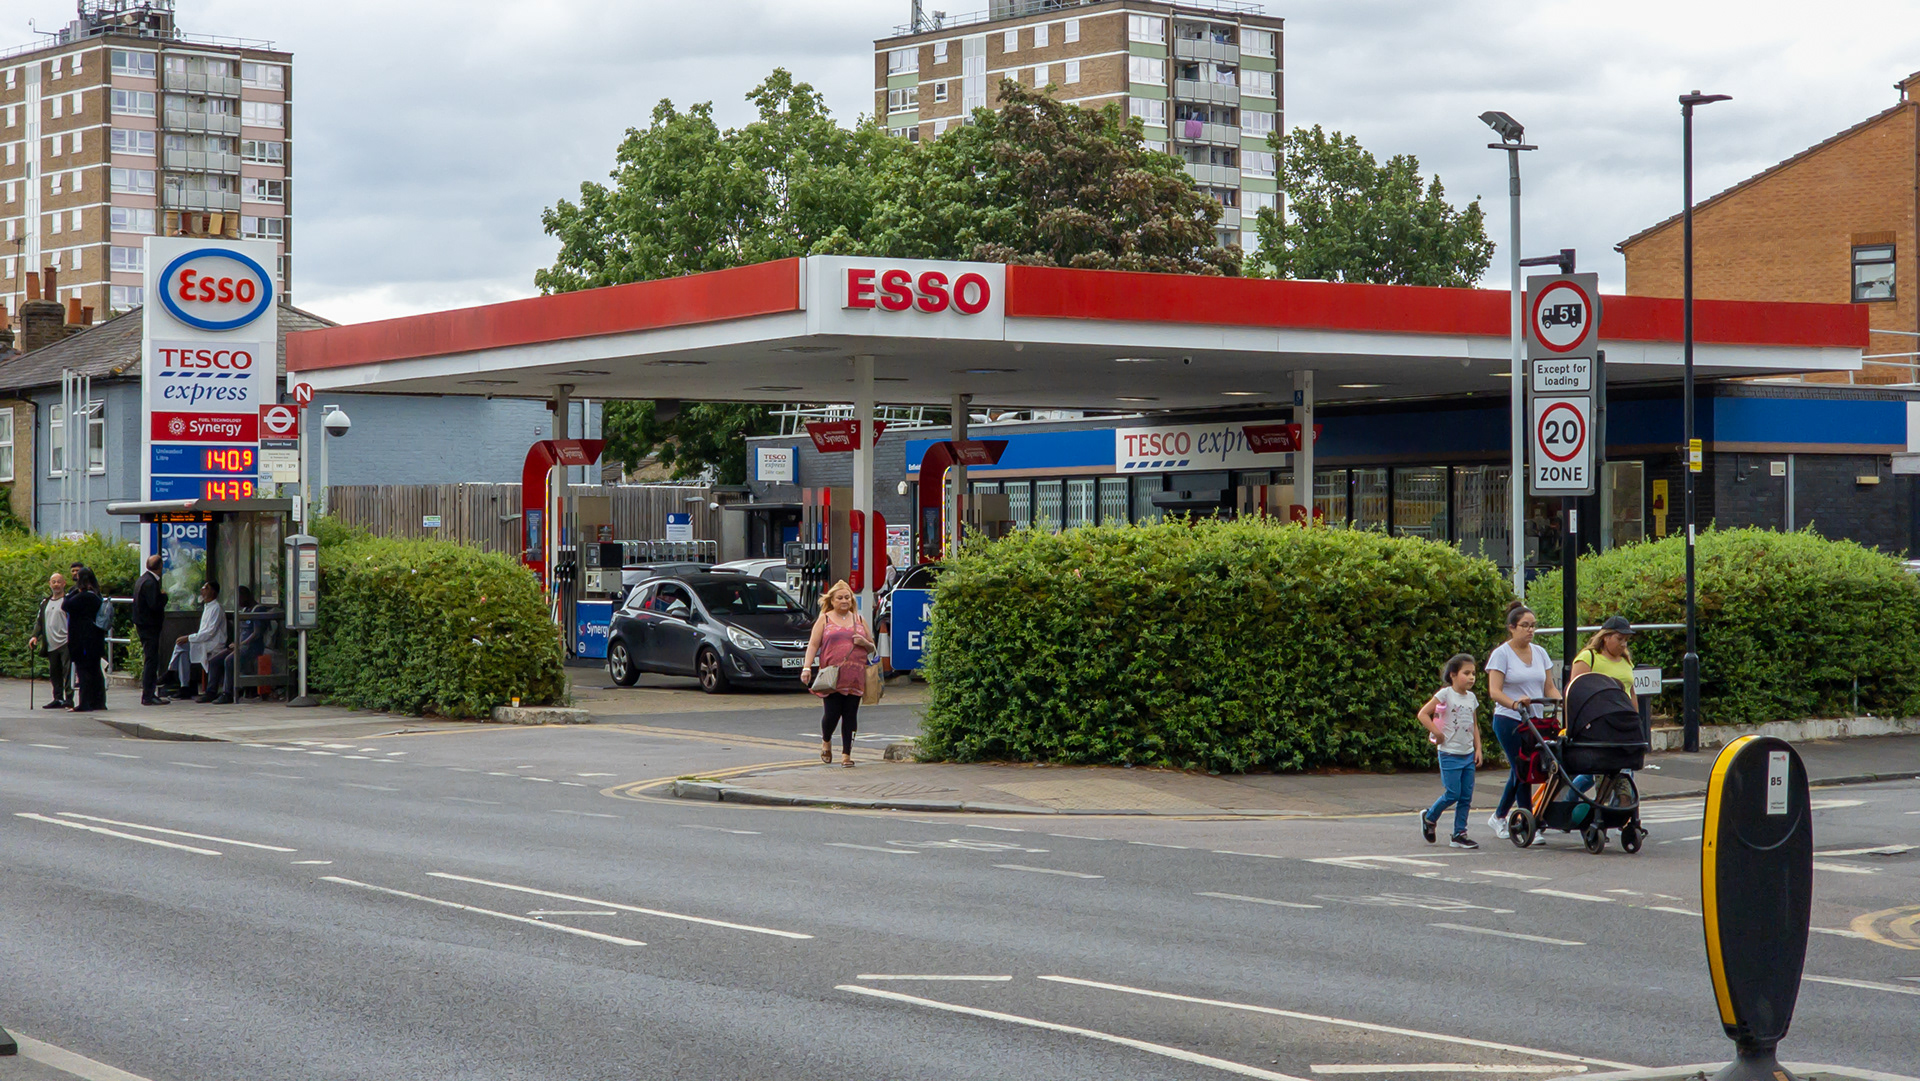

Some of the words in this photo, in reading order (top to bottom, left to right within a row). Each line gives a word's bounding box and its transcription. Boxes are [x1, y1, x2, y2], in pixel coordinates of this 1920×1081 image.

[179, 269, 255, 303] Esso
[847, 268, 991, 315] ESSO
[158, 348, 252, 369] TESCO
[1537, 364, 1570, 375] Except
[1573, 364, 1587, 373] for
[1544, 376, 1579, 387] loading
[163, 383, 248, 405] express
[296, 386, 311, 401] N
[189, 420, 242, 437] Synergy
[850, 424, 857, 434] 5
[1295, 430, 1301, 440] 7
[1545, 420, 1578, 444] 20
[823, 432, 850, 445] Synergy
[1124, 432, 1191, 457] TESCO
[1197, 427, 1251, 462] expr
[1261, 434, 1290, 446] Synergy
[206, 448, 253, 472] 140.9
[1540, 467, 1582, 481] ZONE
[1634, 676, 1651, 688] OAD
